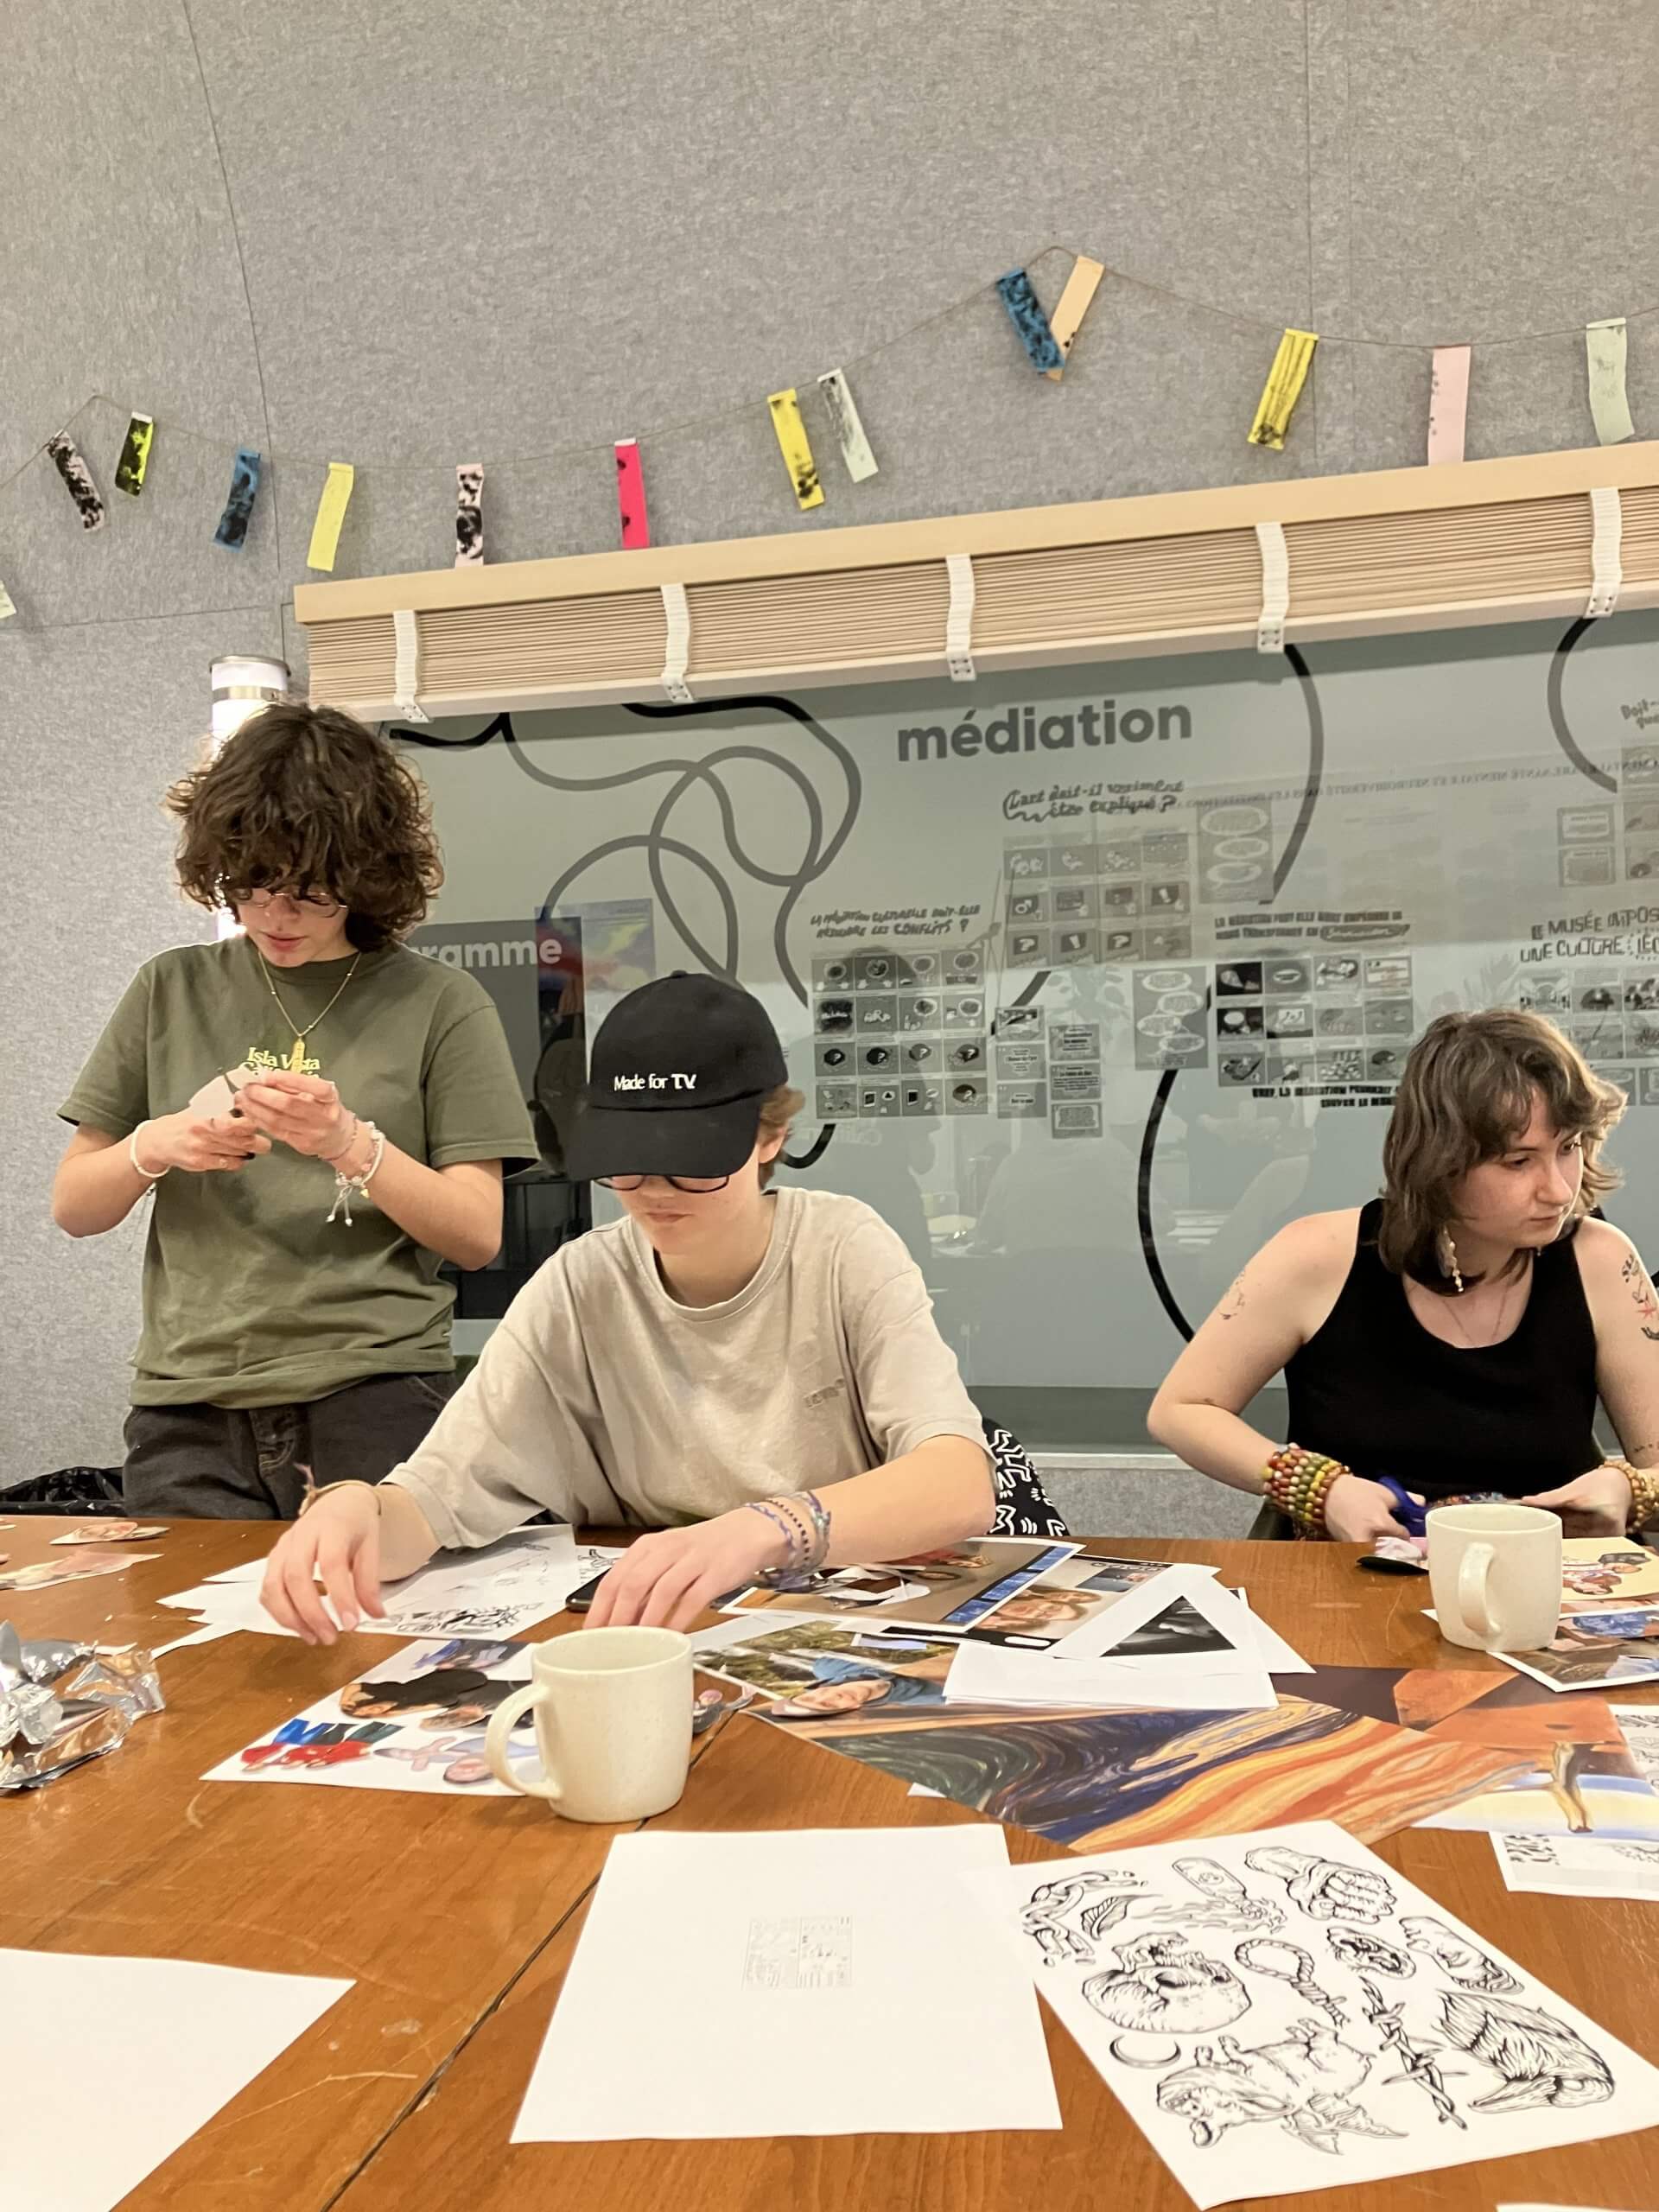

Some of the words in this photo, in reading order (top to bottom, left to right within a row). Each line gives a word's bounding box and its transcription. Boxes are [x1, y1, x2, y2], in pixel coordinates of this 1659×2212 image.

[898, 699, 1192, 762] médiation
[1548, 910, 1604, 934] MUSÉE
[410, 938, 563, 968] ramme
[1521, 943, 1553, 963] UNE
[1556, 935, 1625, 957] CULTURE
[246, 1046, 278, 1067] Isla
[280, 1053, 321, 1071] Vta
[613, 1073, 646, 1091] Made
[648, 1073, 669, 1090] for
[670, 1073, 697, 1090] TV
